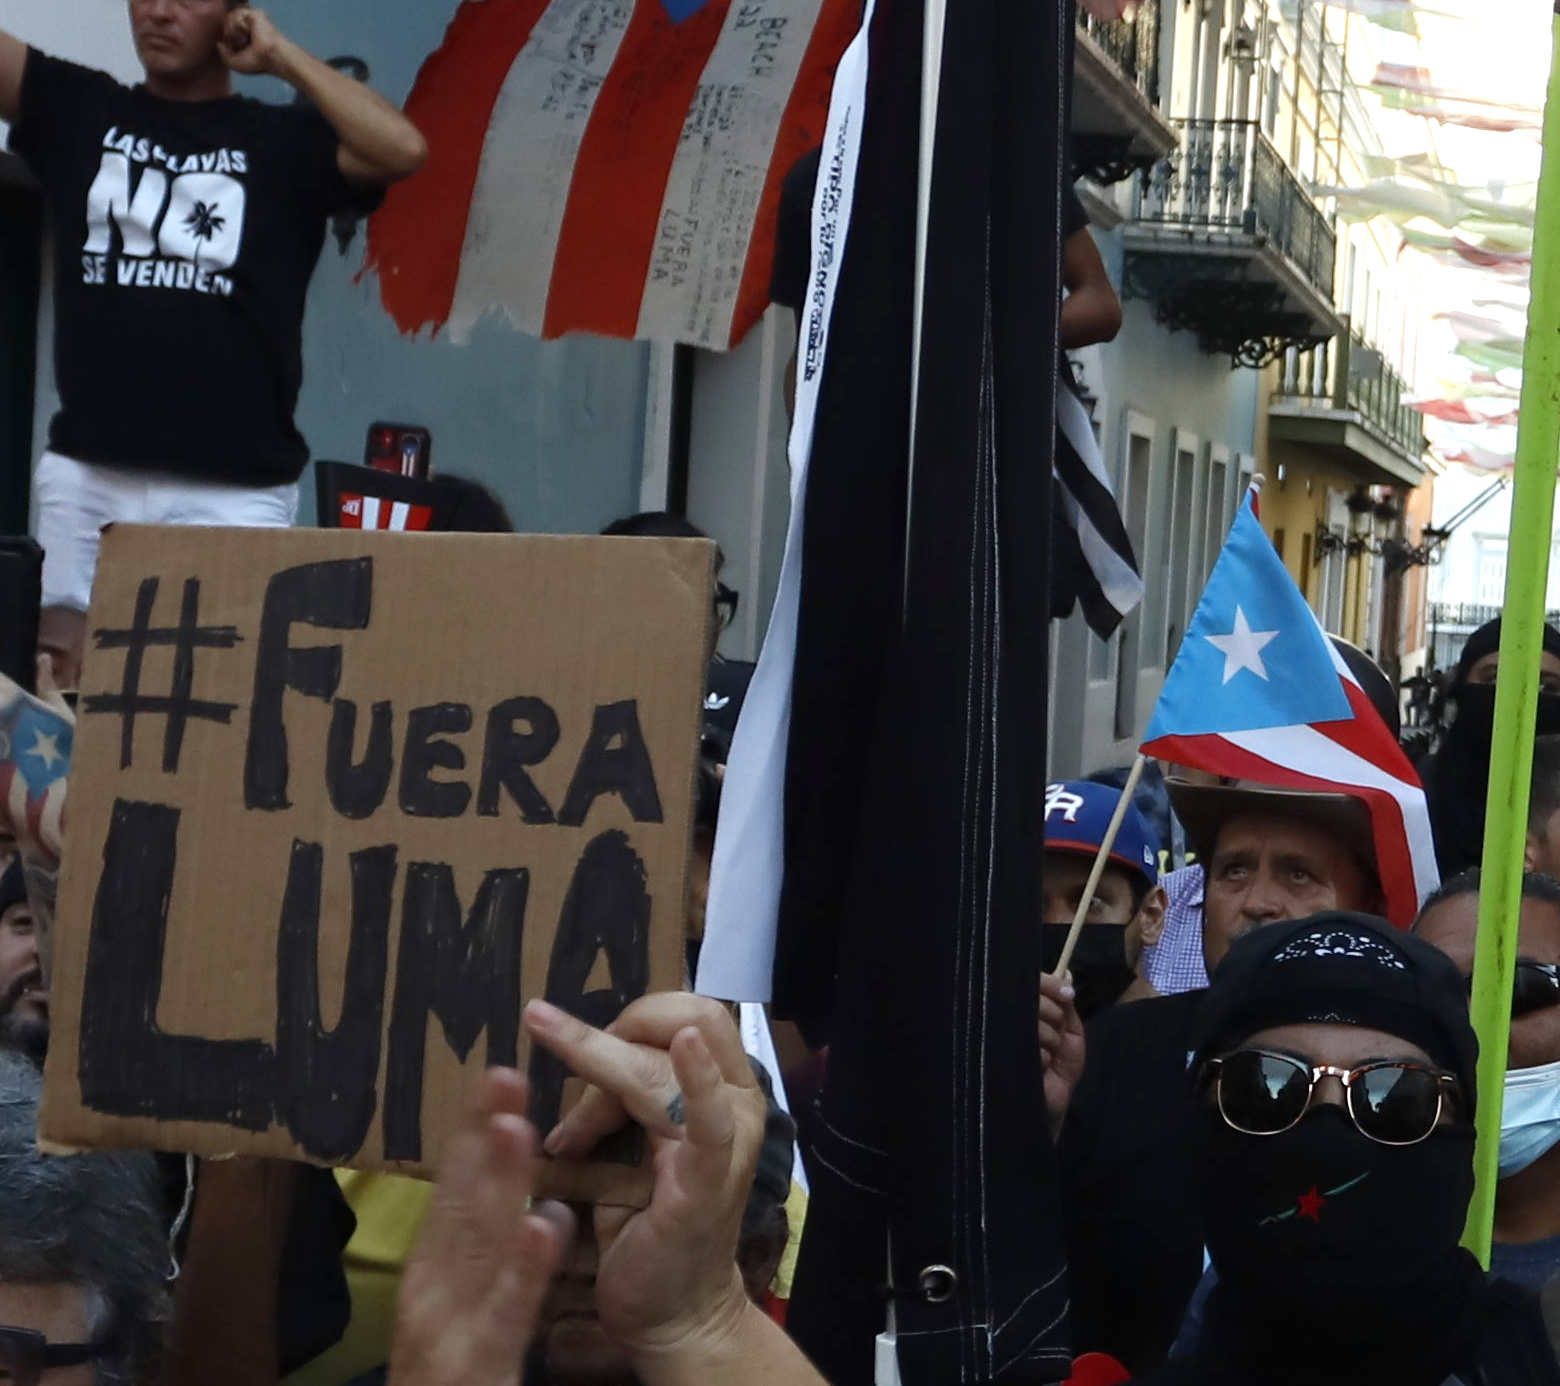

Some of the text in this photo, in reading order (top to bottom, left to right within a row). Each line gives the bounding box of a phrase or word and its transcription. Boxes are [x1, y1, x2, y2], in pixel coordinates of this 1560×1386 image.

[747, 17, 788, 78] BEACH
[102, 125, 152, 163] LAS
[83, 151, 246, 273] NO
[651, 208, 680, 281] LUMA
[81, 254, 234, 296] SE VENDEN
[671, 216, 698, 287] FUERA
[78, 797, 653, 1163] LUMA
